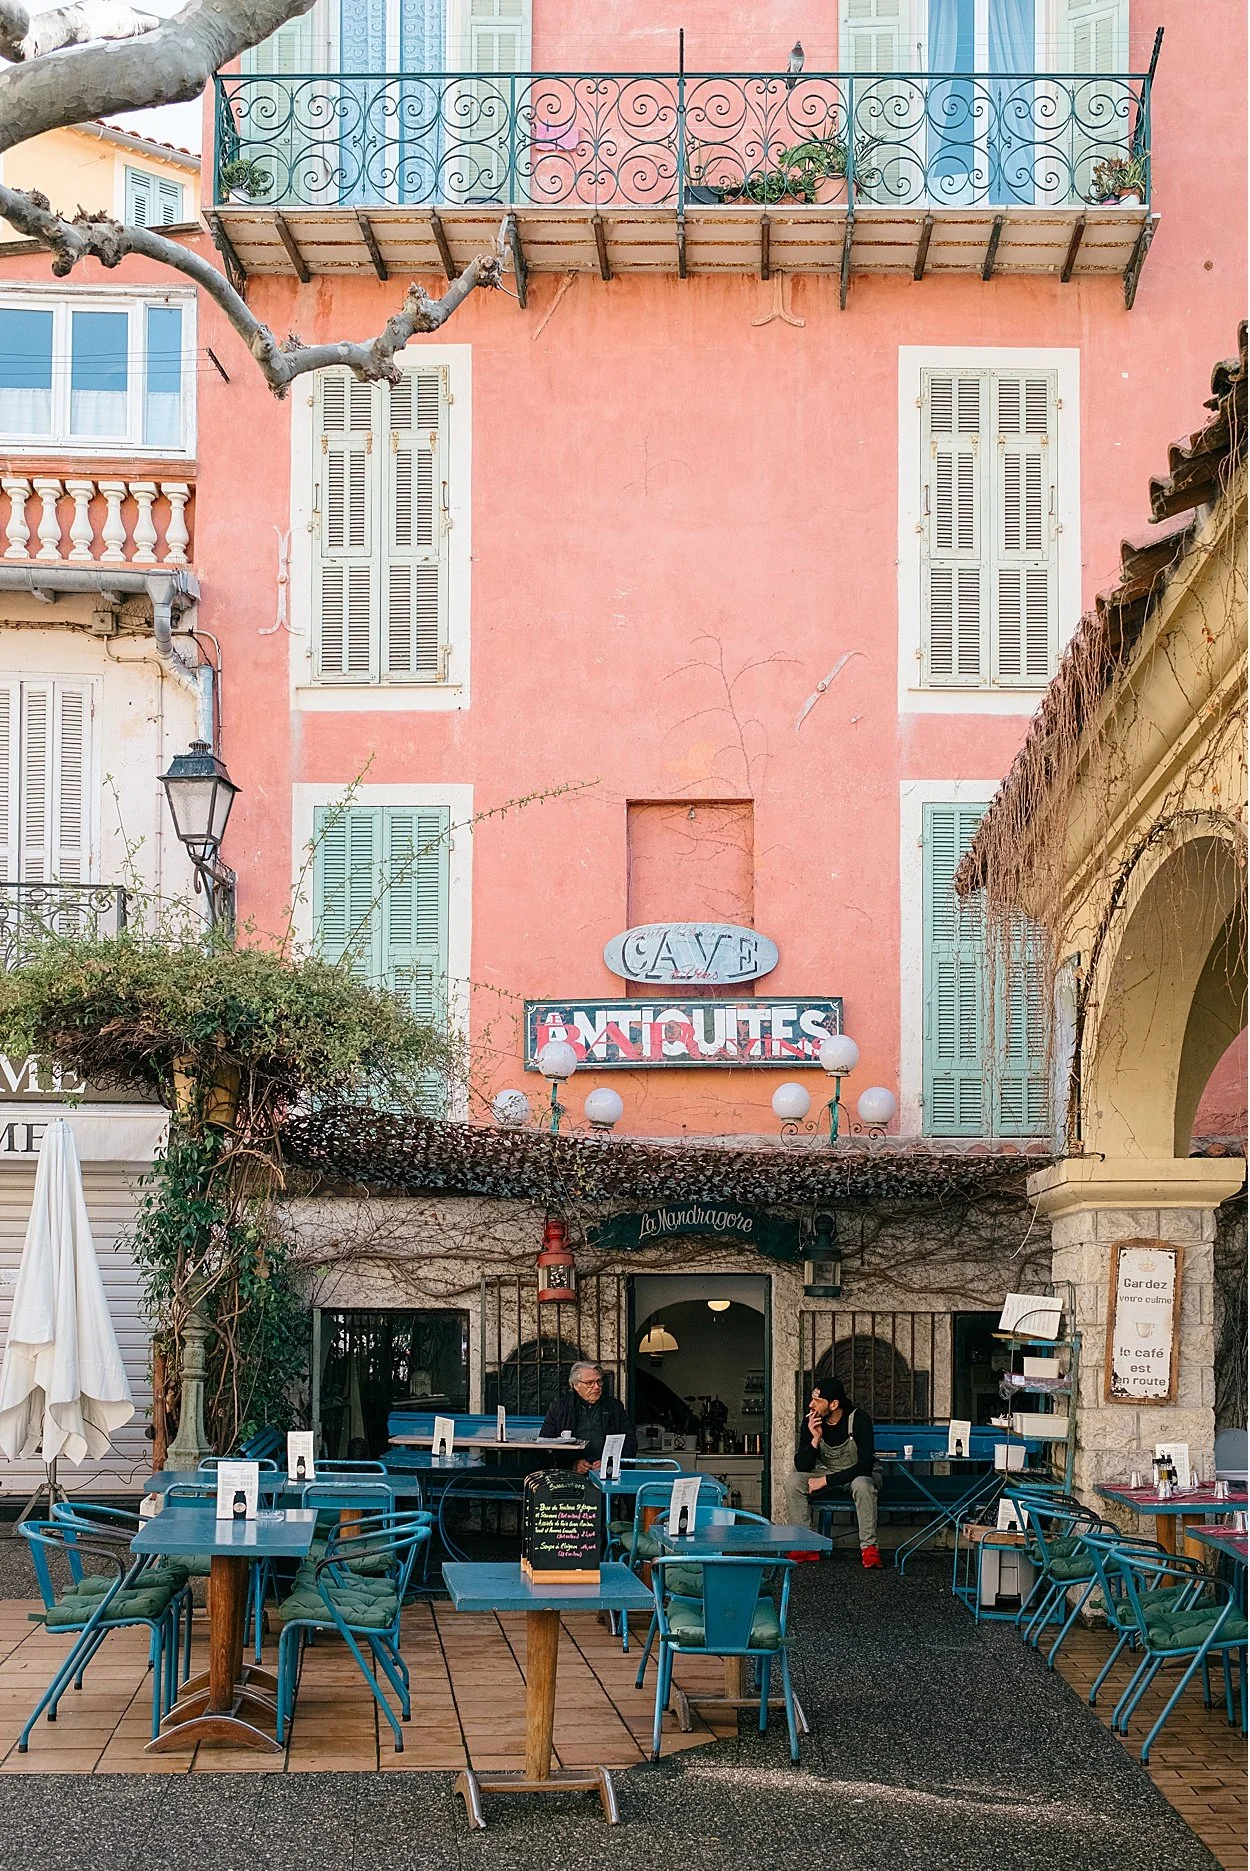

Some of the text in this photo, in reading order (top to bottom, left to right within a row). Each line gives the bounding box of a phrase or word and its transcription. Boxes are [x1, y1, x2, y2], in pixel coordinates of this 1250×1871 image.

[622, 929, 758, 981] CAVE
[654, 1204, 753, 1235] Mandragore
[1123, 1277, 1168, 1290] Gardez
[1119, 1295, 1172, 1305] votre calme
[1119, 1346, 1164, 1359] le café
[1130, 1363, 1151, 1373] est
[1116, 1376, 1166, 1386] en route
